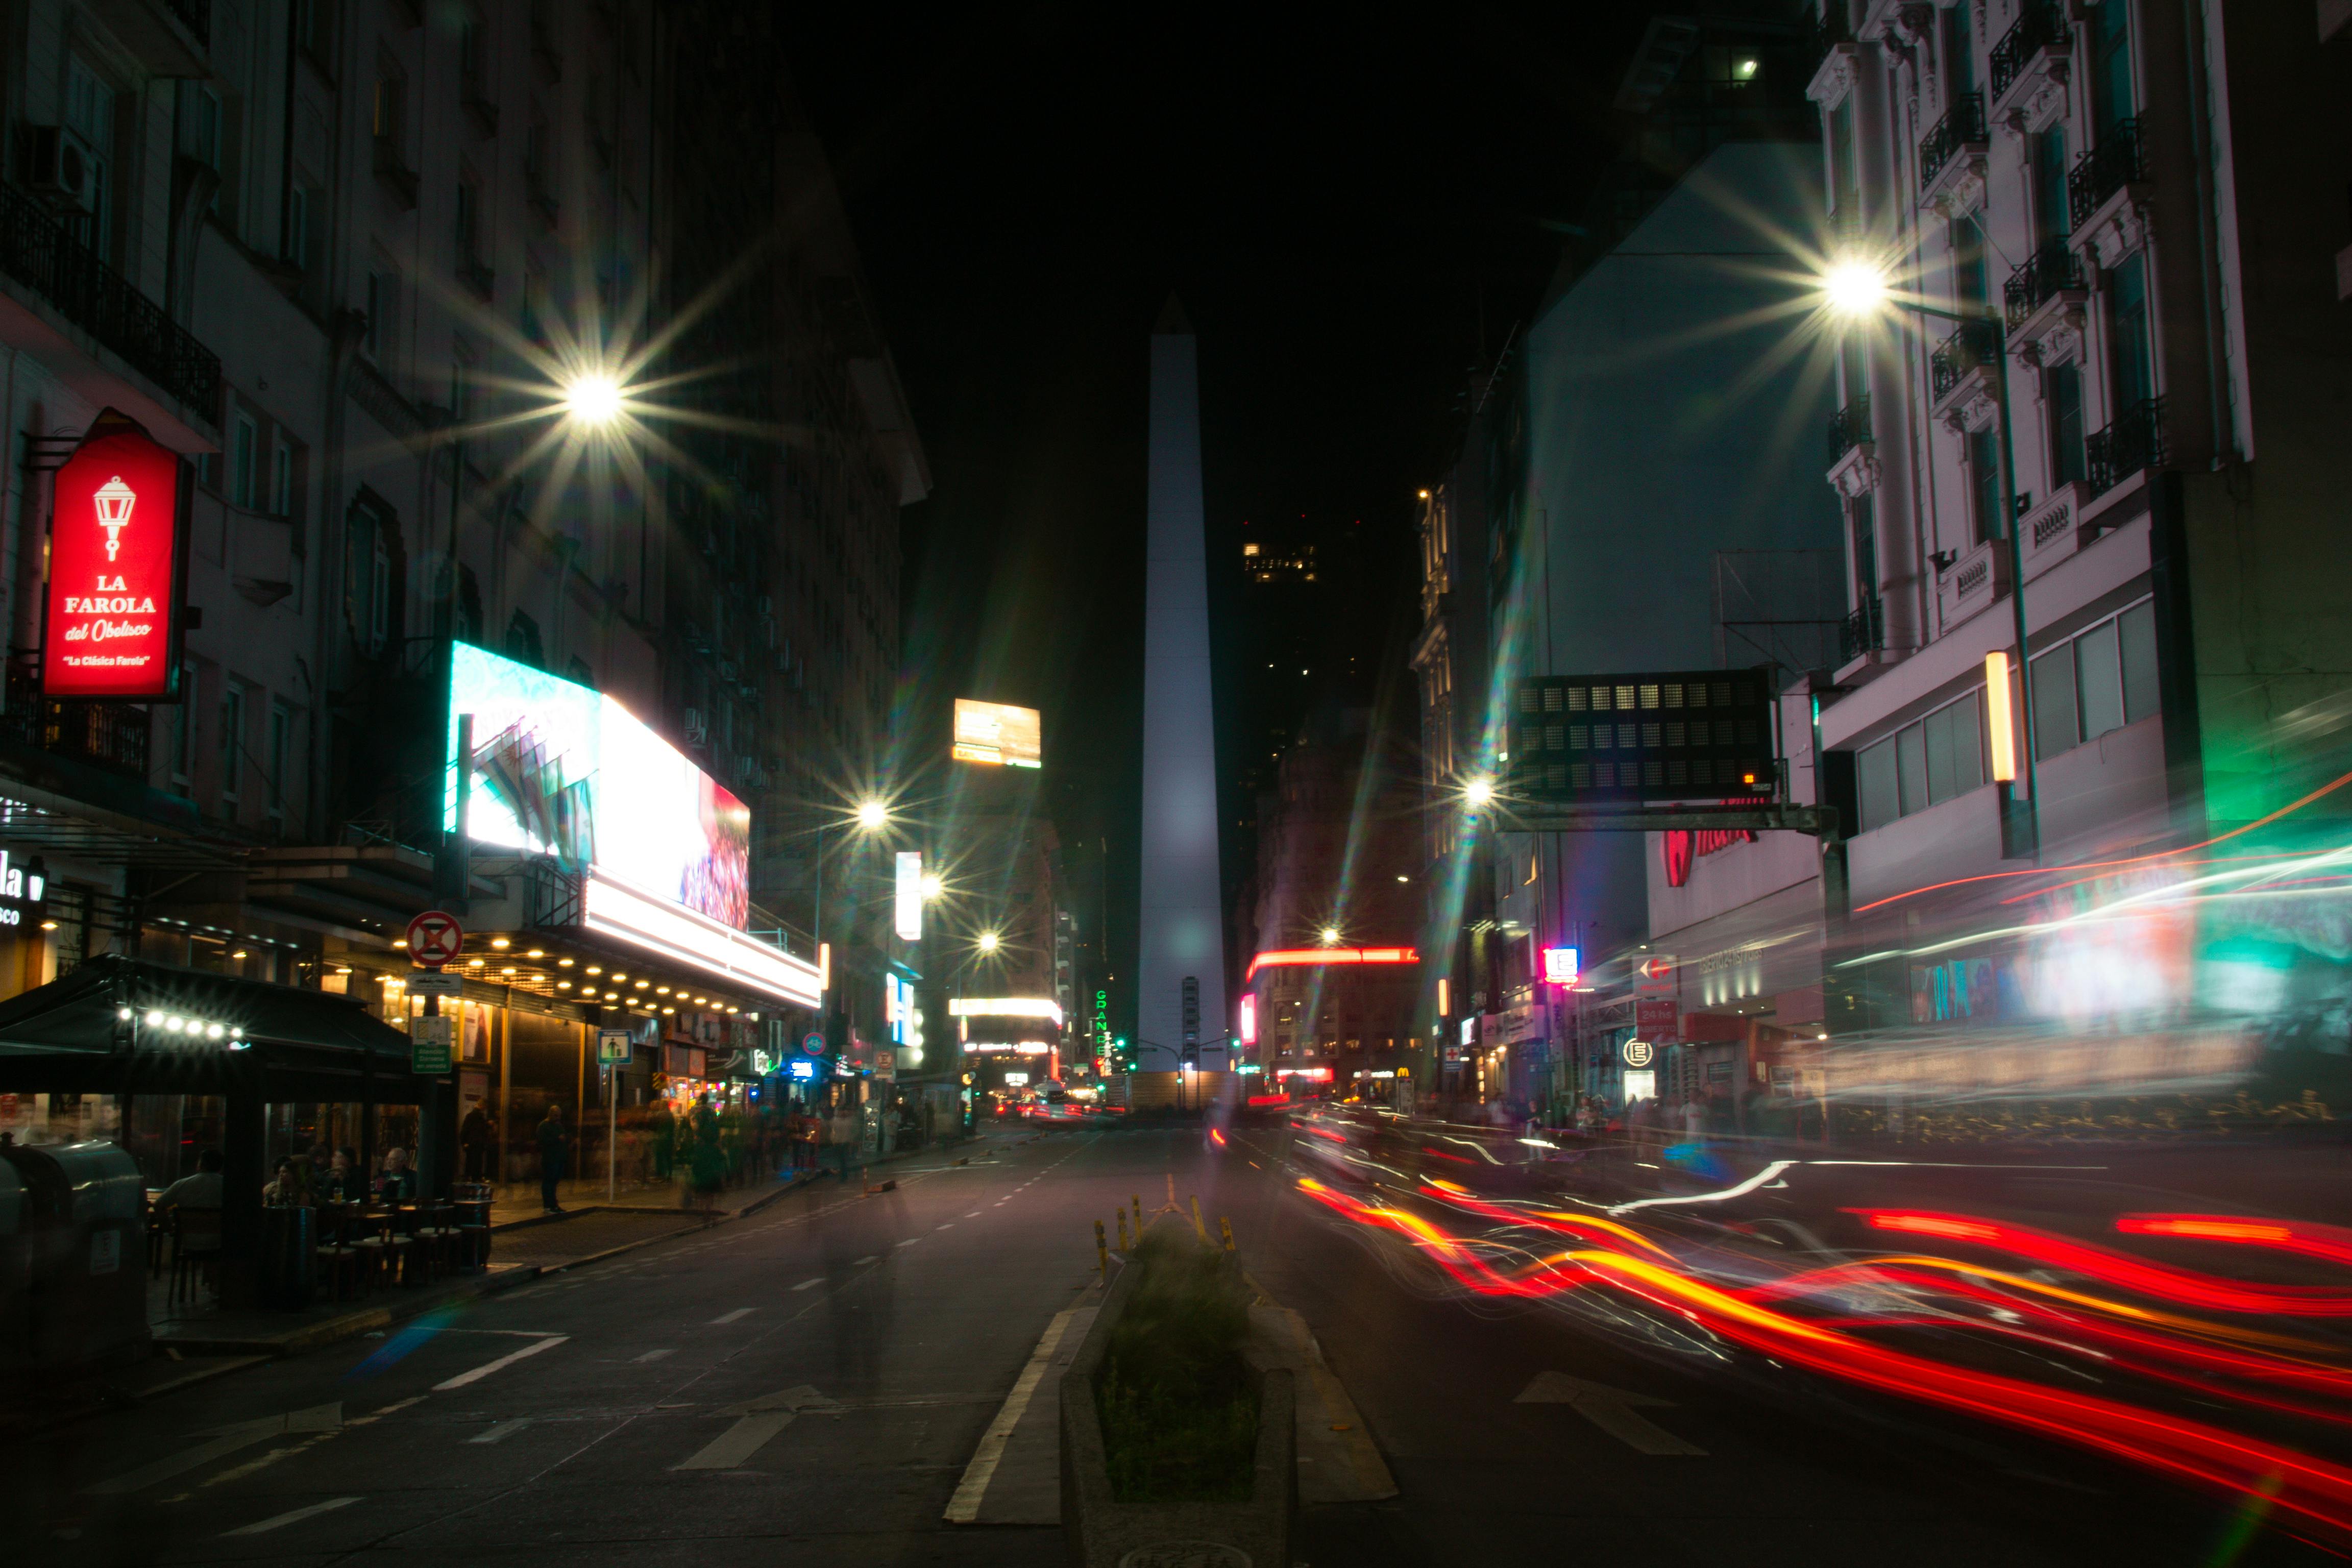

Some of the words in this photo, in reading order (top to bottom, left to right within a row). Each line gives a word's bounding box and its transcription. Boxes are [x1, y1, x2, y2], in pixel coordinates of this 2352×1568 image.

[96, 575, 127, 591] LA
[64, 598, 156, 613] FAROLA
[65, 623, 88, 641] del
[91, 619, 152, 642] Obelisco
[82, 655, 114, 666] Clásica
[1641, 1010, 1657, 1020] 24
[1659, 1010, 1672, 1019] hs
